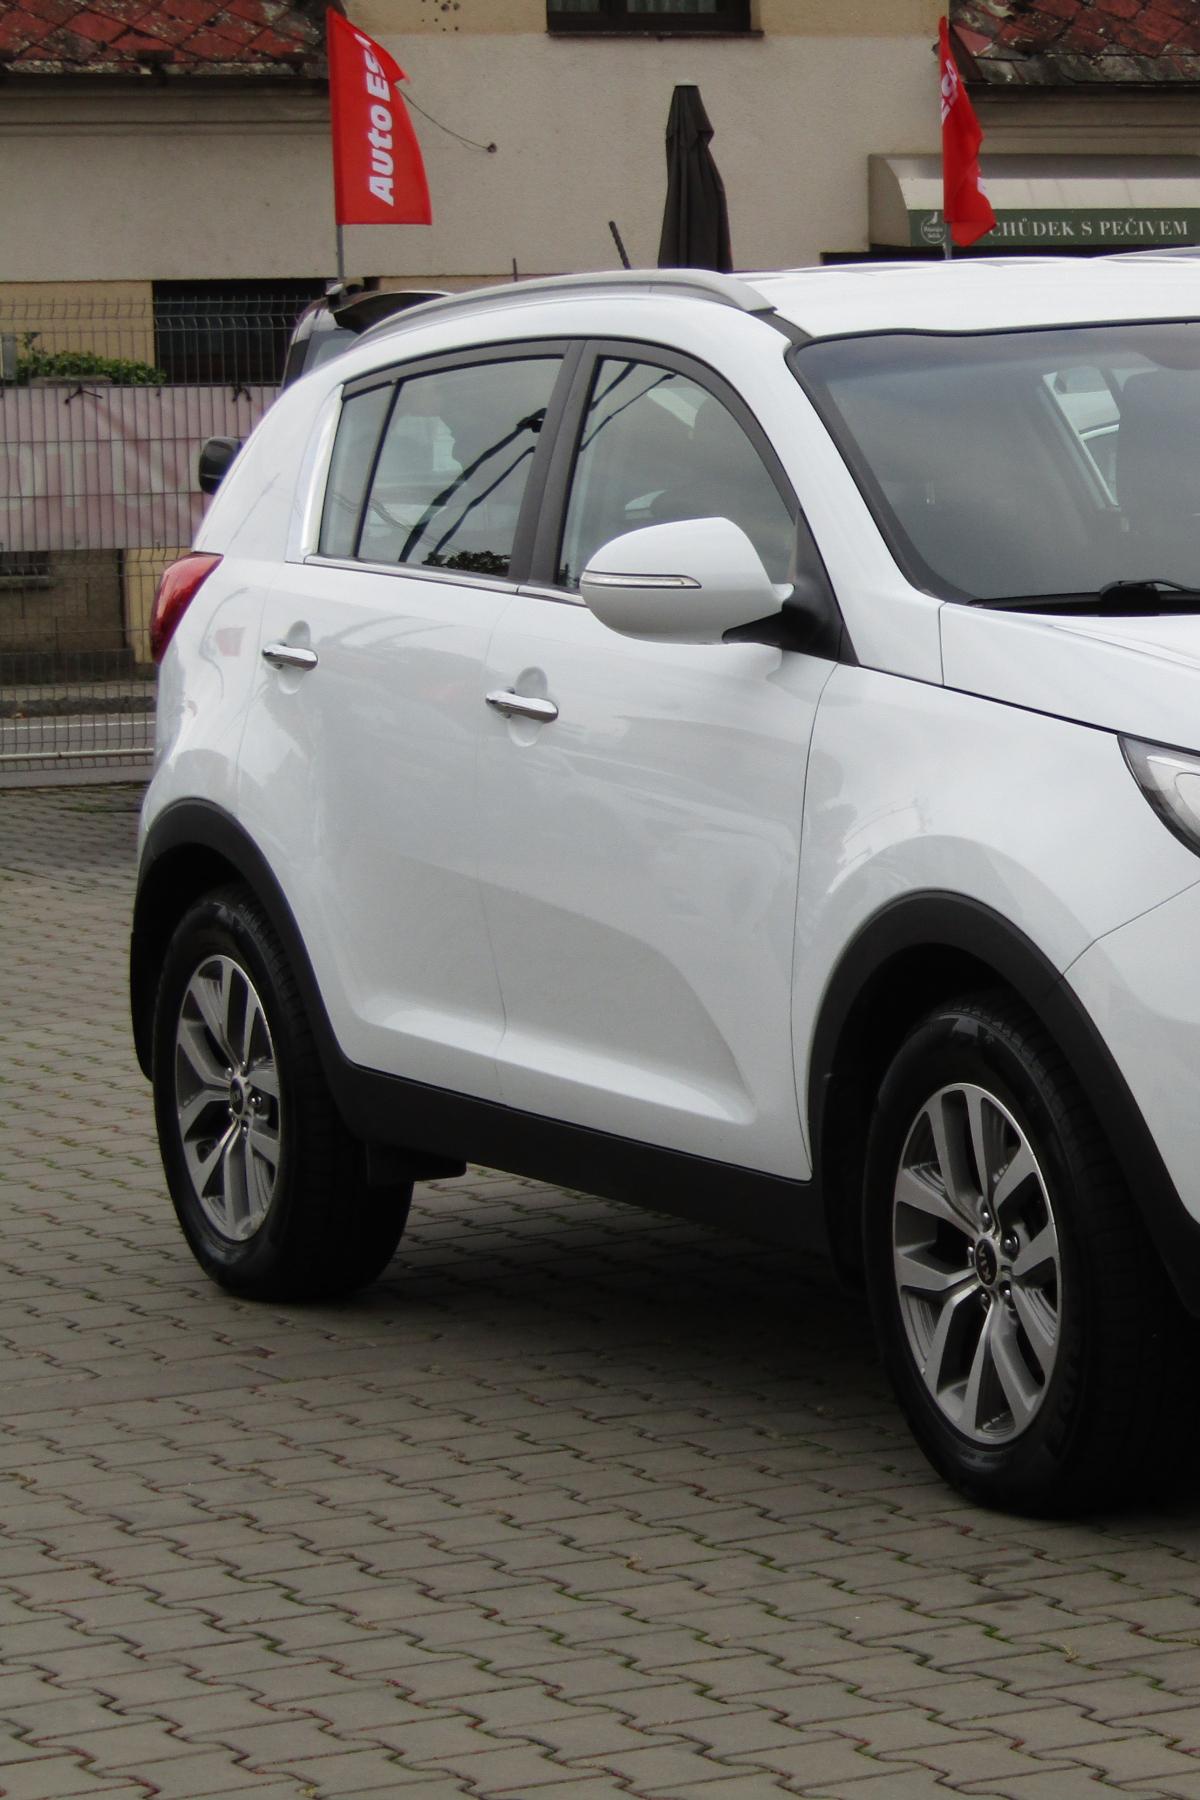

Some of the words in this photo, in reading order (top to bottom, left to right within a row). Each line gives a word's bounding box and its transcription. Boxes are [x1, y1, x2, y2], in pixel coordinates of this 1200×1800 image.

[368, 104, 395, 207] Auto
[1081, 220, 1093, 236] S
[1100, 216, 1188, 236] PEČIVEM
